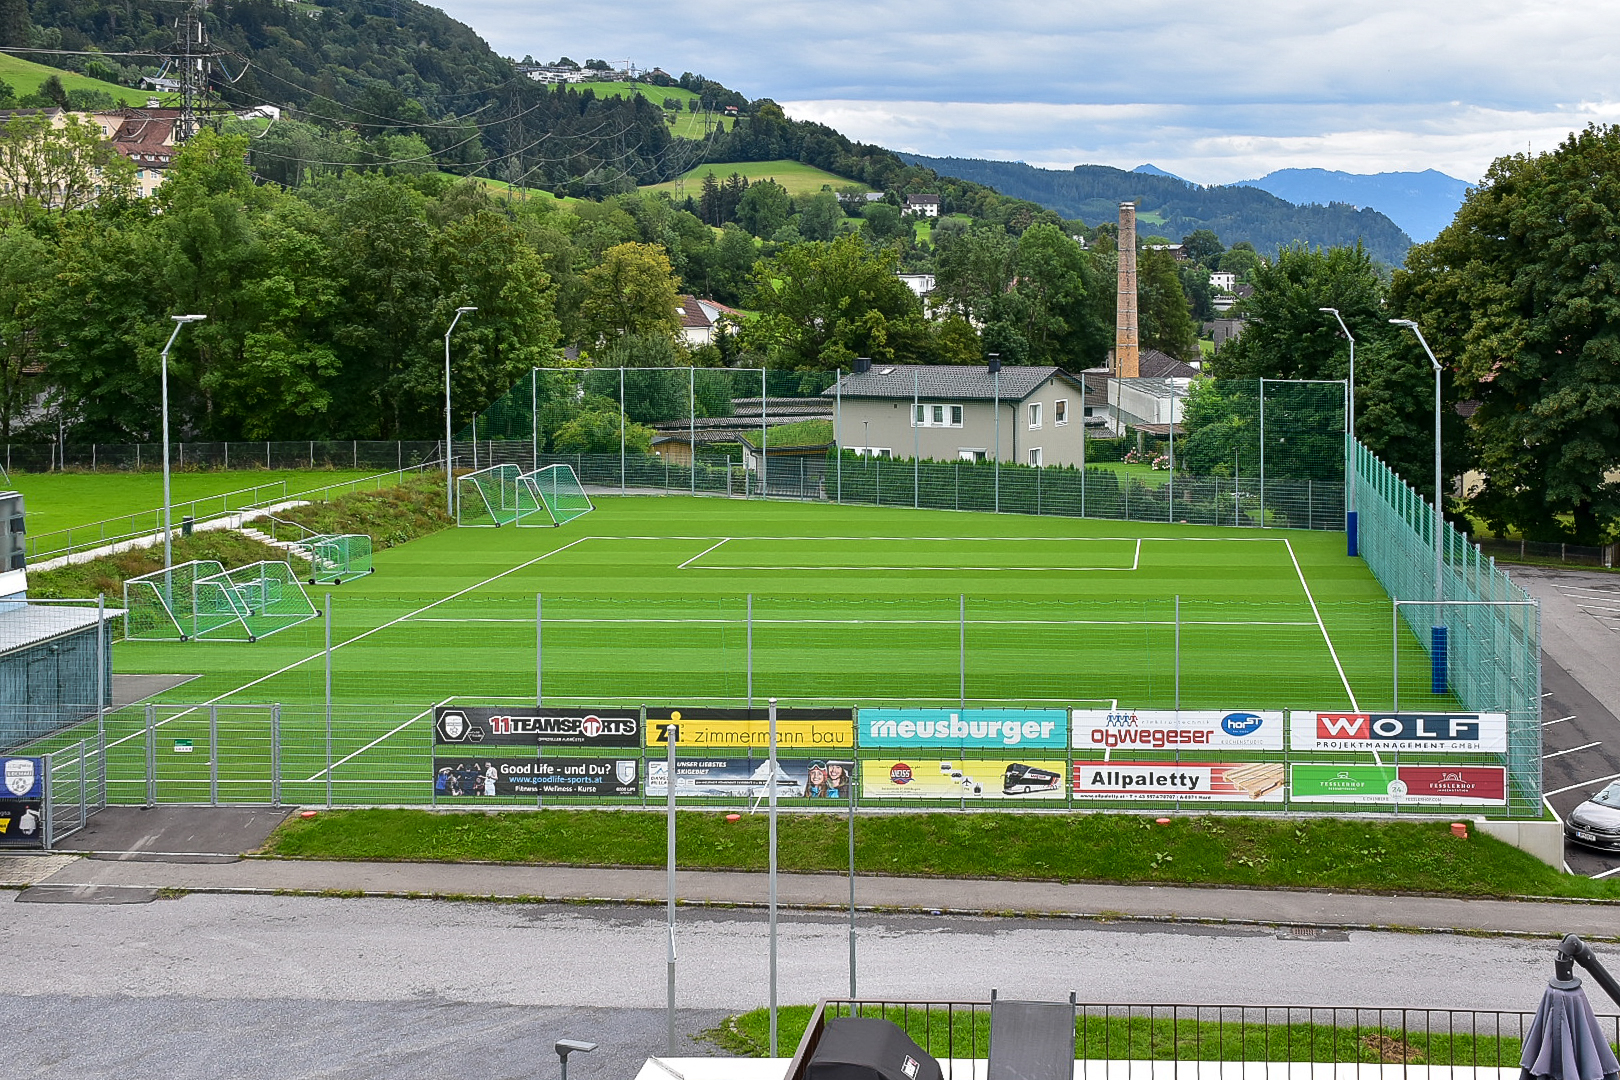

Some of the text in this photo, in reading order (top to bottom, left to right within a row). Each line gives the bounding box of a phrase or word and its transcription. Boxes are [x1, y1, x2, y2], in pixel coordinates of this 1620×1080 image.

[812, 725, 844, 743] bau
[870, 714, 1055, 745] meusburger
[1321, 717, 1479, 737] WOLF
[1091, 729, 1214, 747] obwegeser
[1316, 741, 1445, 749] PROJEKTMANAGEMENT
[500, 764, 531, 774] Good
[534, 764, 554, 774] Life
[564, 764, 586, 774] und
[589, 764, 611, 774] Du?
[509, 775, 603, 784] www.goodlife-sports.at
[1091, 771, 1200, 790] Allpaletty
